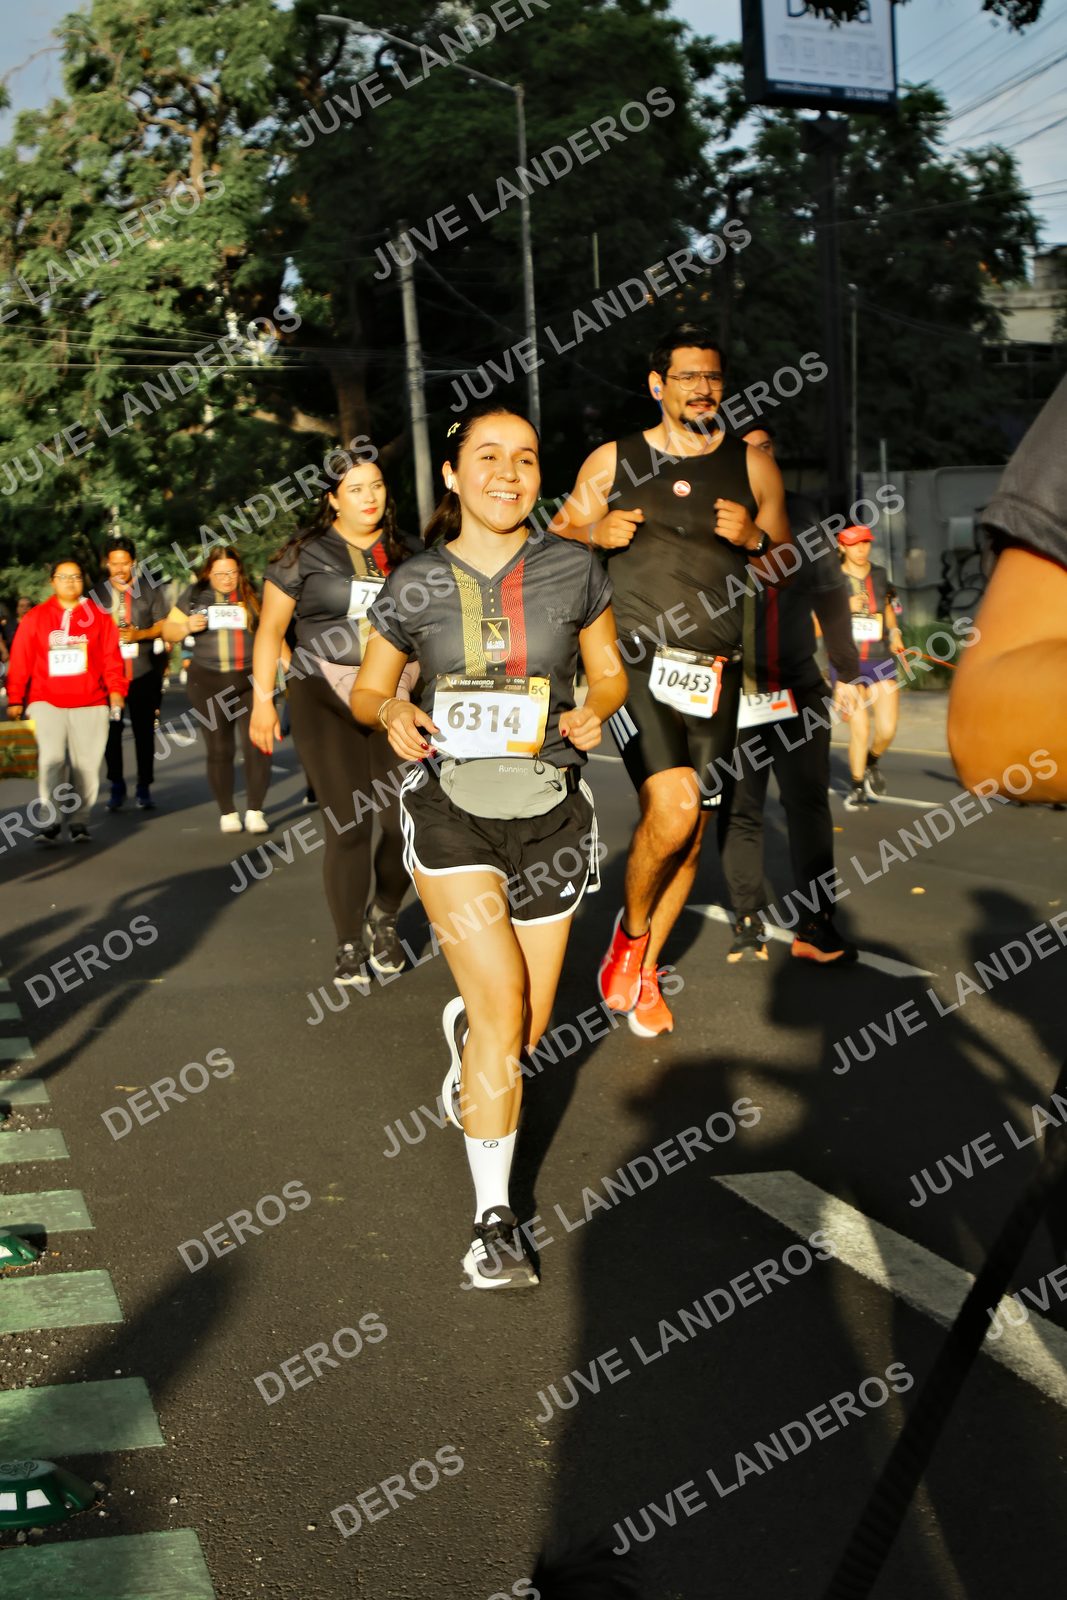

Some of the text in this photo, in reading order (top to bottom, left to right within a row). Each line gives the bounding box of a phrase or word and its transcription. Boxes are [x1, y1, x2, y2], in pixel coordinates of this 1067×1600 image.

[530, 685, 545, 696] 5K
[658, 666, 712, 693] 10453
[447, 701, 521, 735] 6314
